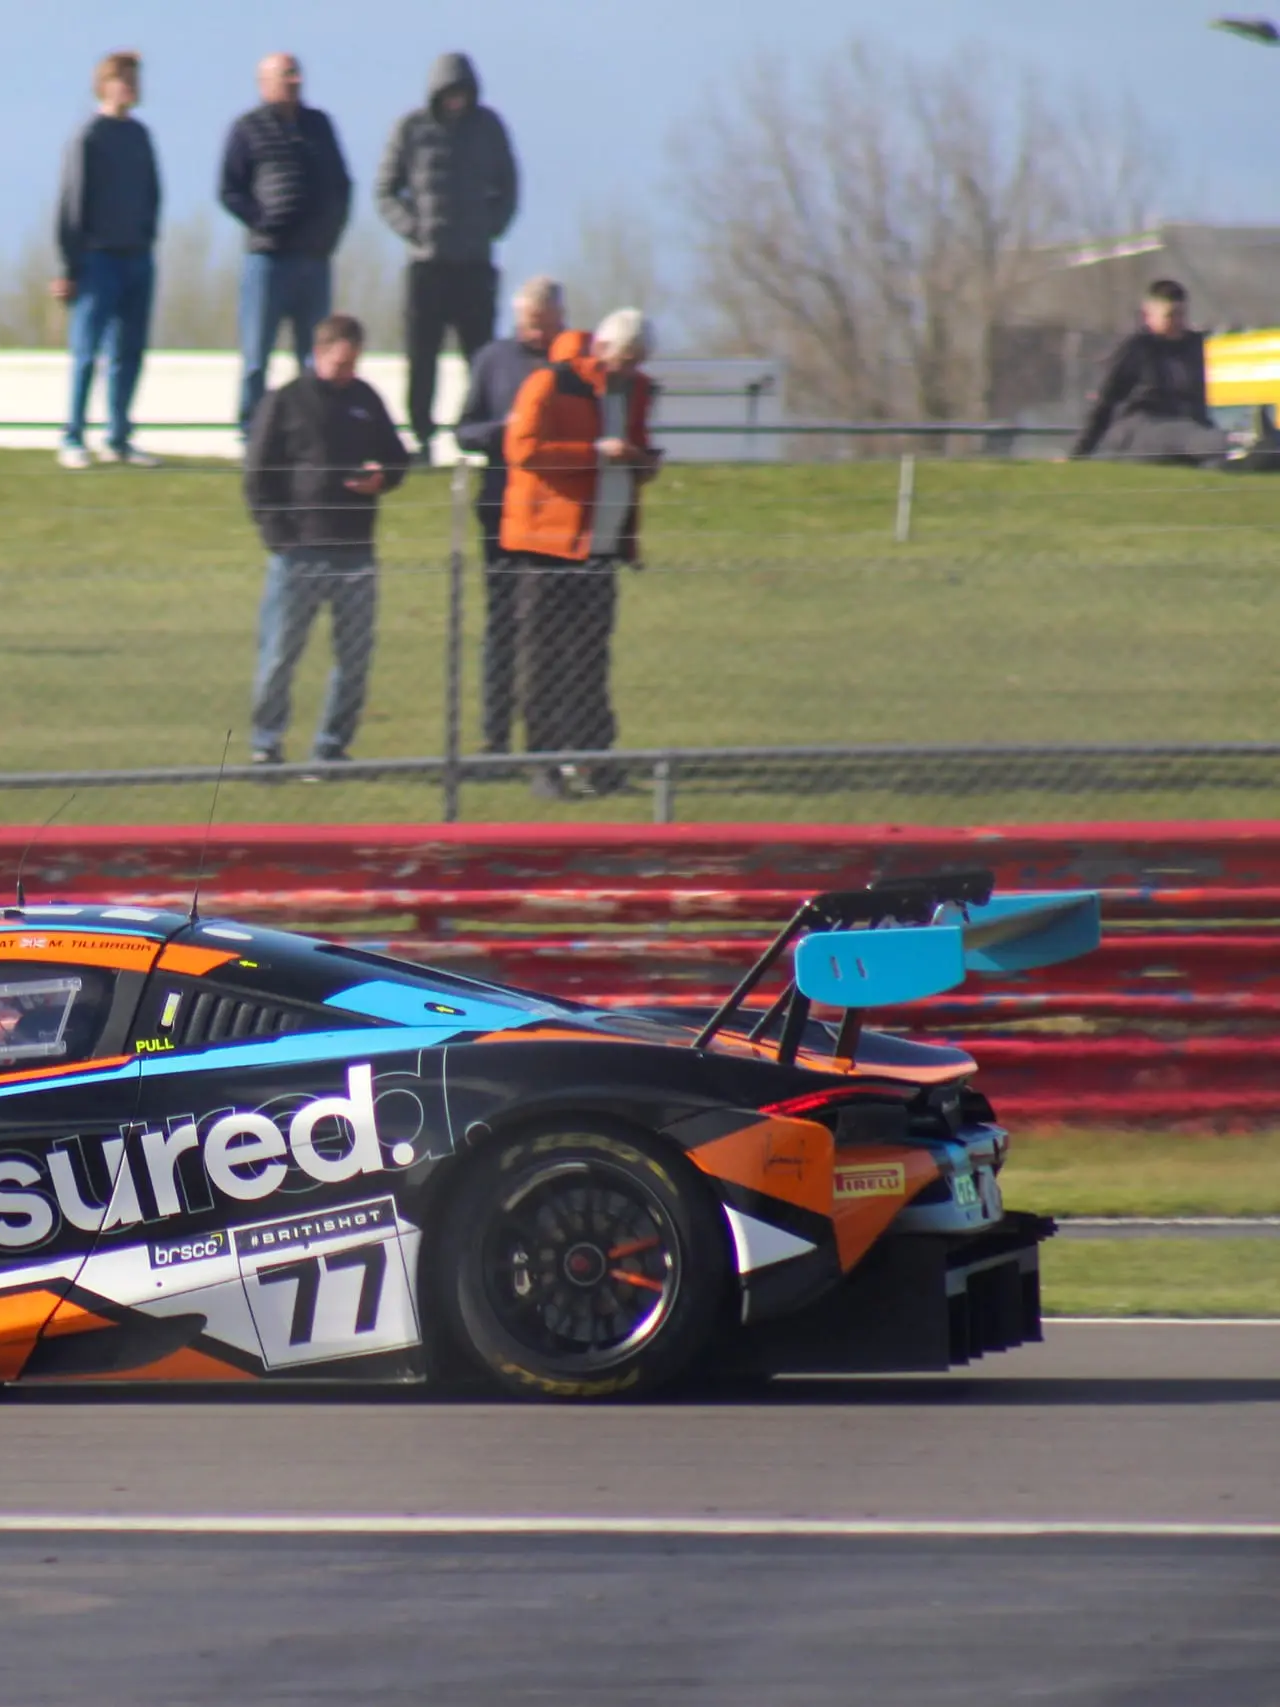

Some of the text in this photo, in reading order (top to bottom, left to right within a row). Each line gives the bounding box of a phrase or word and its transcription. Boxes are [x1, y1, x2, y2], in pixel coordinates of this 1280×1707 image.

[48, 939, 64, 949] M.
[135, 1037, 174, 1053] PULL
[834, 1168, 900, 1193] PIRELLI
[250, 1209, 382, 1248] #BRITISHGT
[154, 1238, 220, 1265] brscc
[255, 1242, 387, 1347] 77
